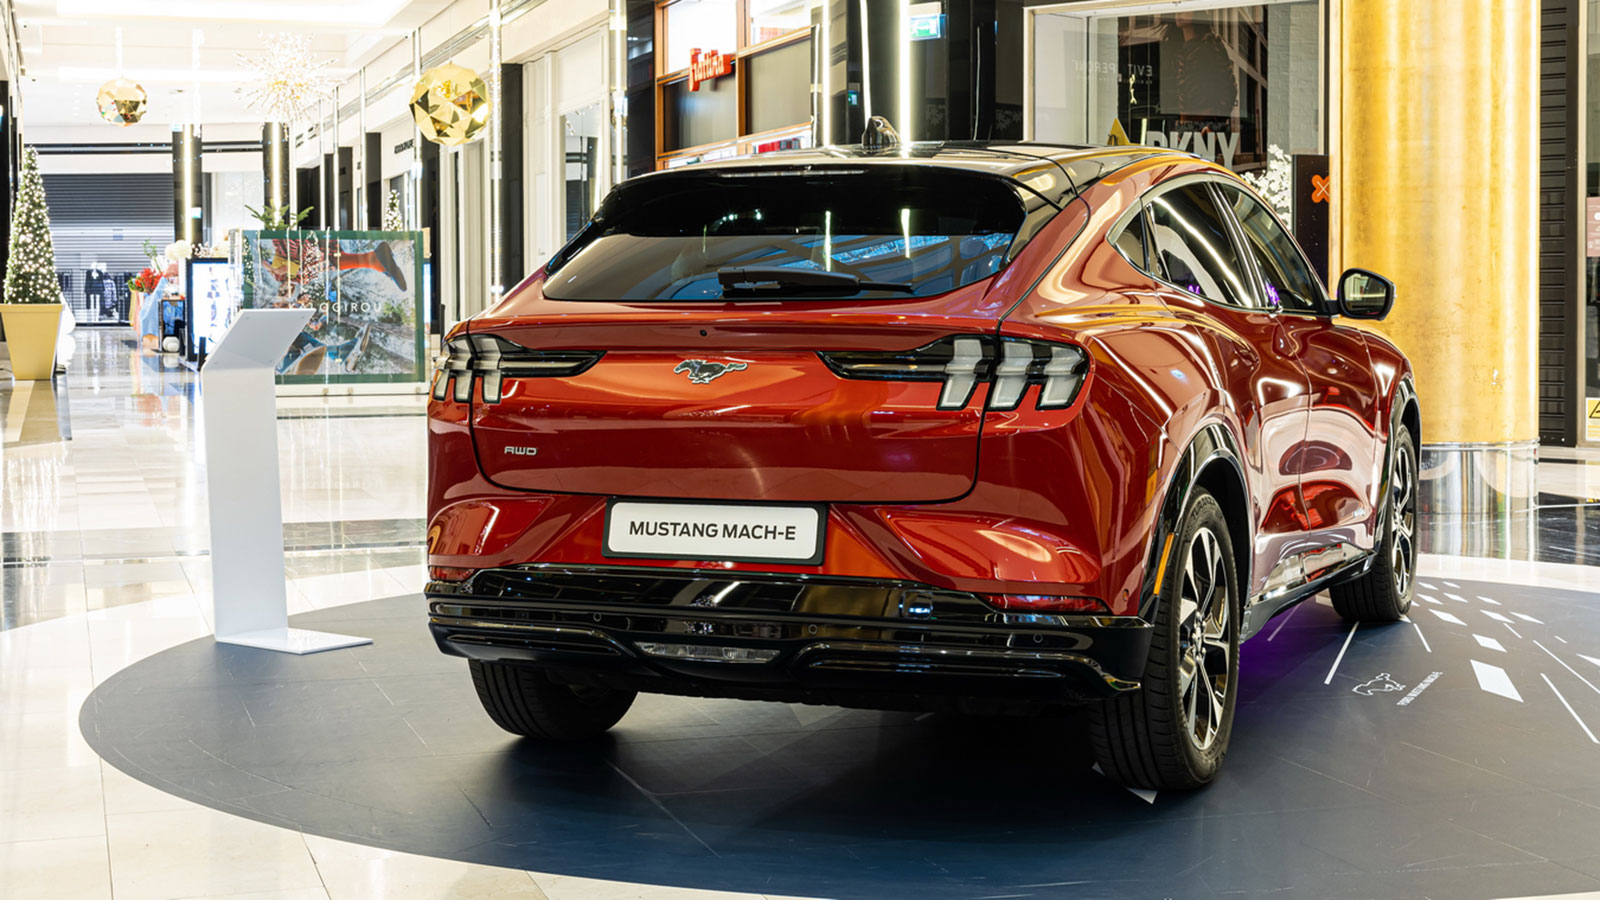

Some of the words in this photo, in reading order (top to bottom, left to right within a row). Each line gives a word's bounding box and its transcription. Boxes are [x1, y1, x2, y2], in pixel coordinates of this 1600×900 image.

[504, 445, 538, 456] AWD
[629, 521, 719, 538] MUSTANG
[722, 523, 796, 541] MACH-E
